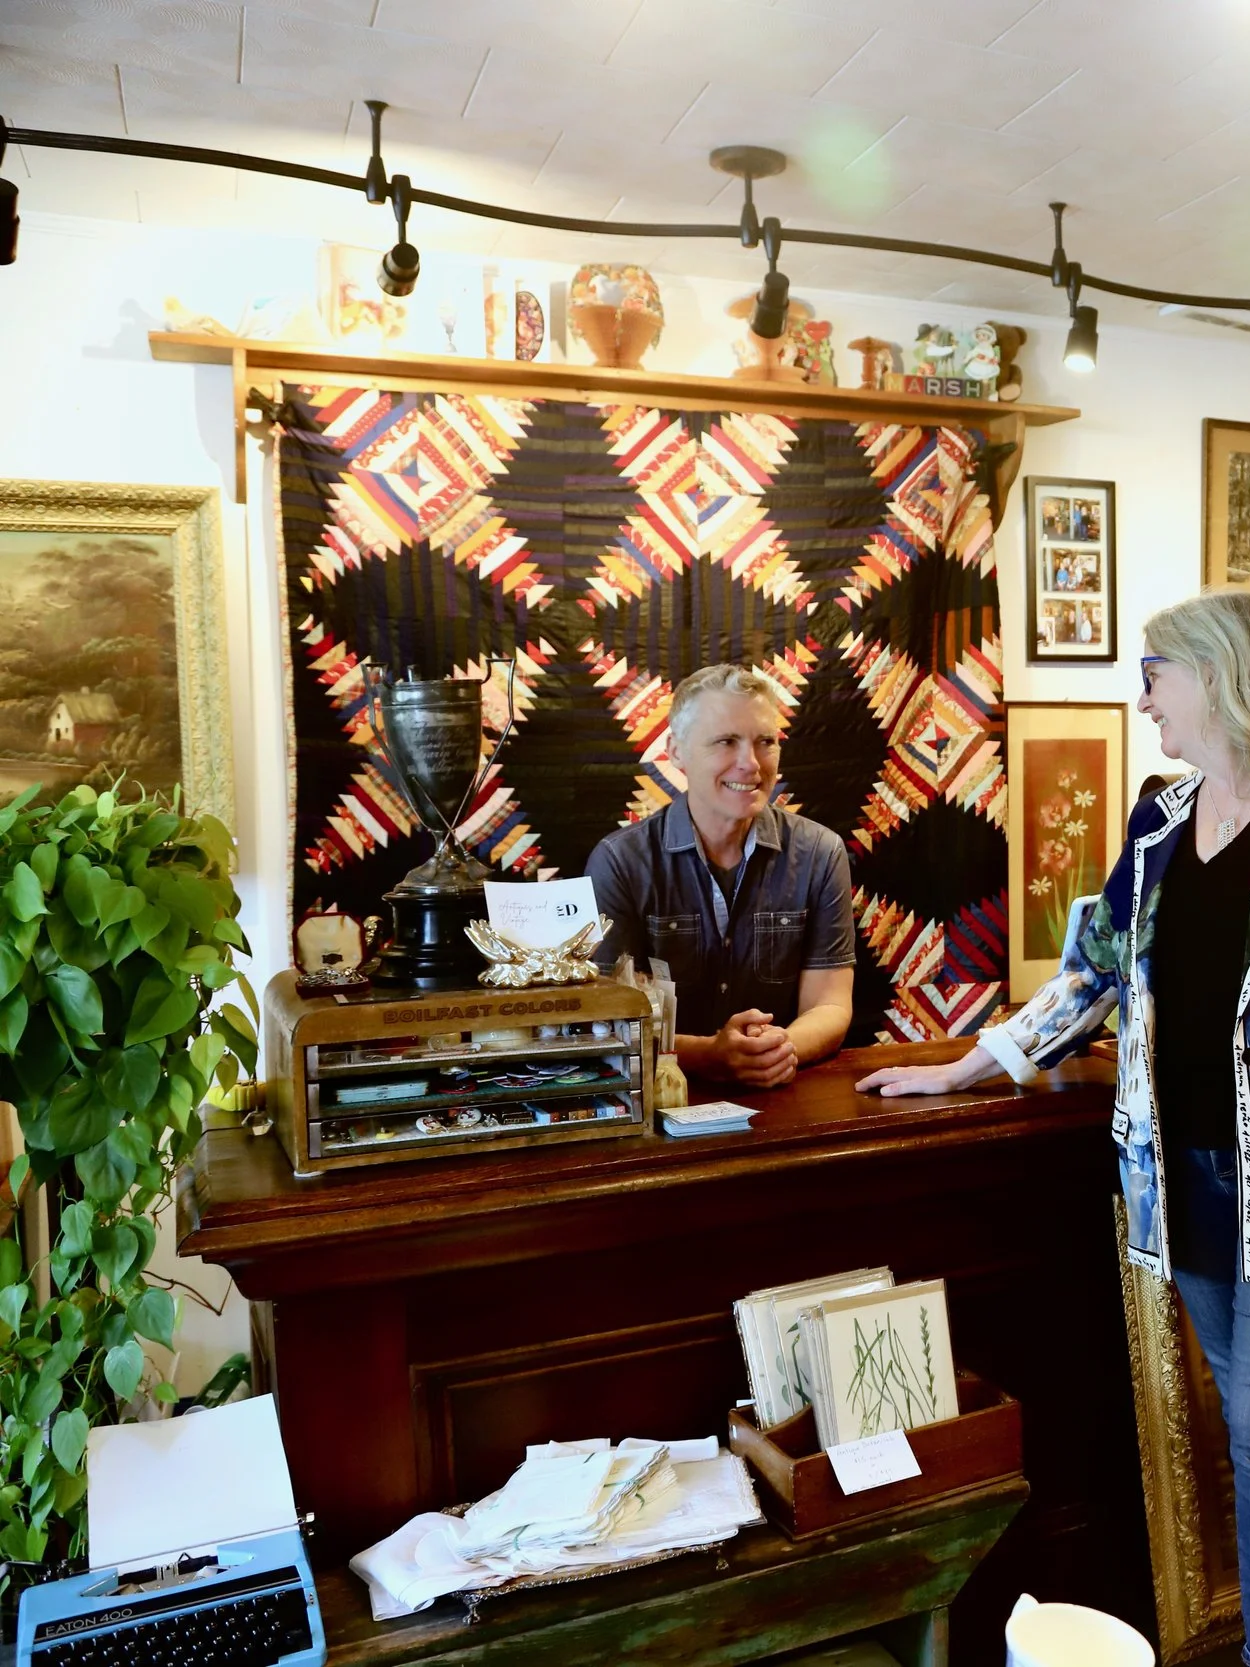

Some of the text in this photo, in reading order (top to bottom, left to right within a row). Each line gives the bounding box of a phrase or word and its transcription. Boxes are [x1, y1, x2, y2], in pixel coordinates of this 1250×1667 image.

[886, 374, 980, 397] MARSH
[383, 998, 582, 1024] BOILFAST COLORS
[46, 1608, 133, 1637] EATON 400
